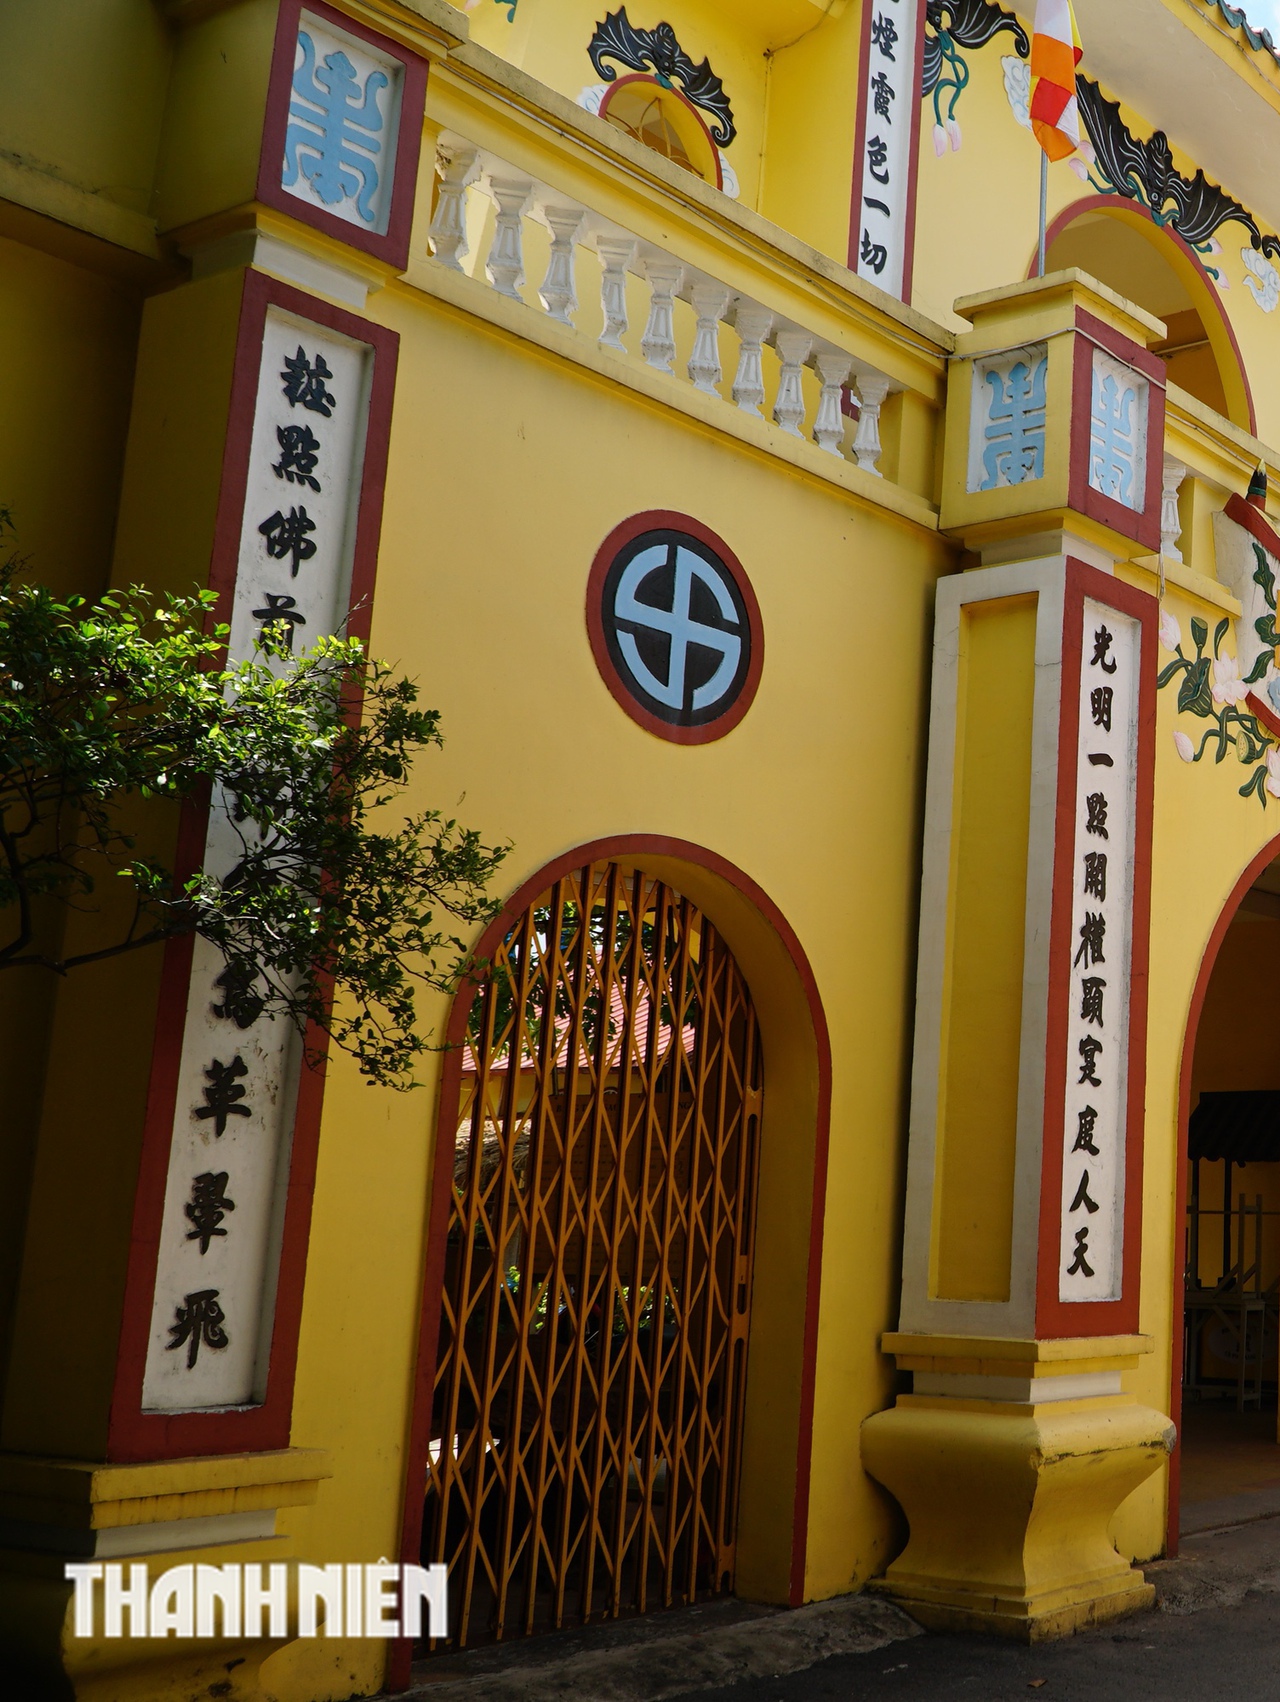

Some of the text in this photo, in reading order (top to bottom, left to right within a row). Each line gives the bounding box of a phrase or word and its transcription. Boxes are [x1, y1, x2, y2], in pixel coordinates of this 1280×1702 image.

[861, 0, 899, 275] 煙霞色一切
